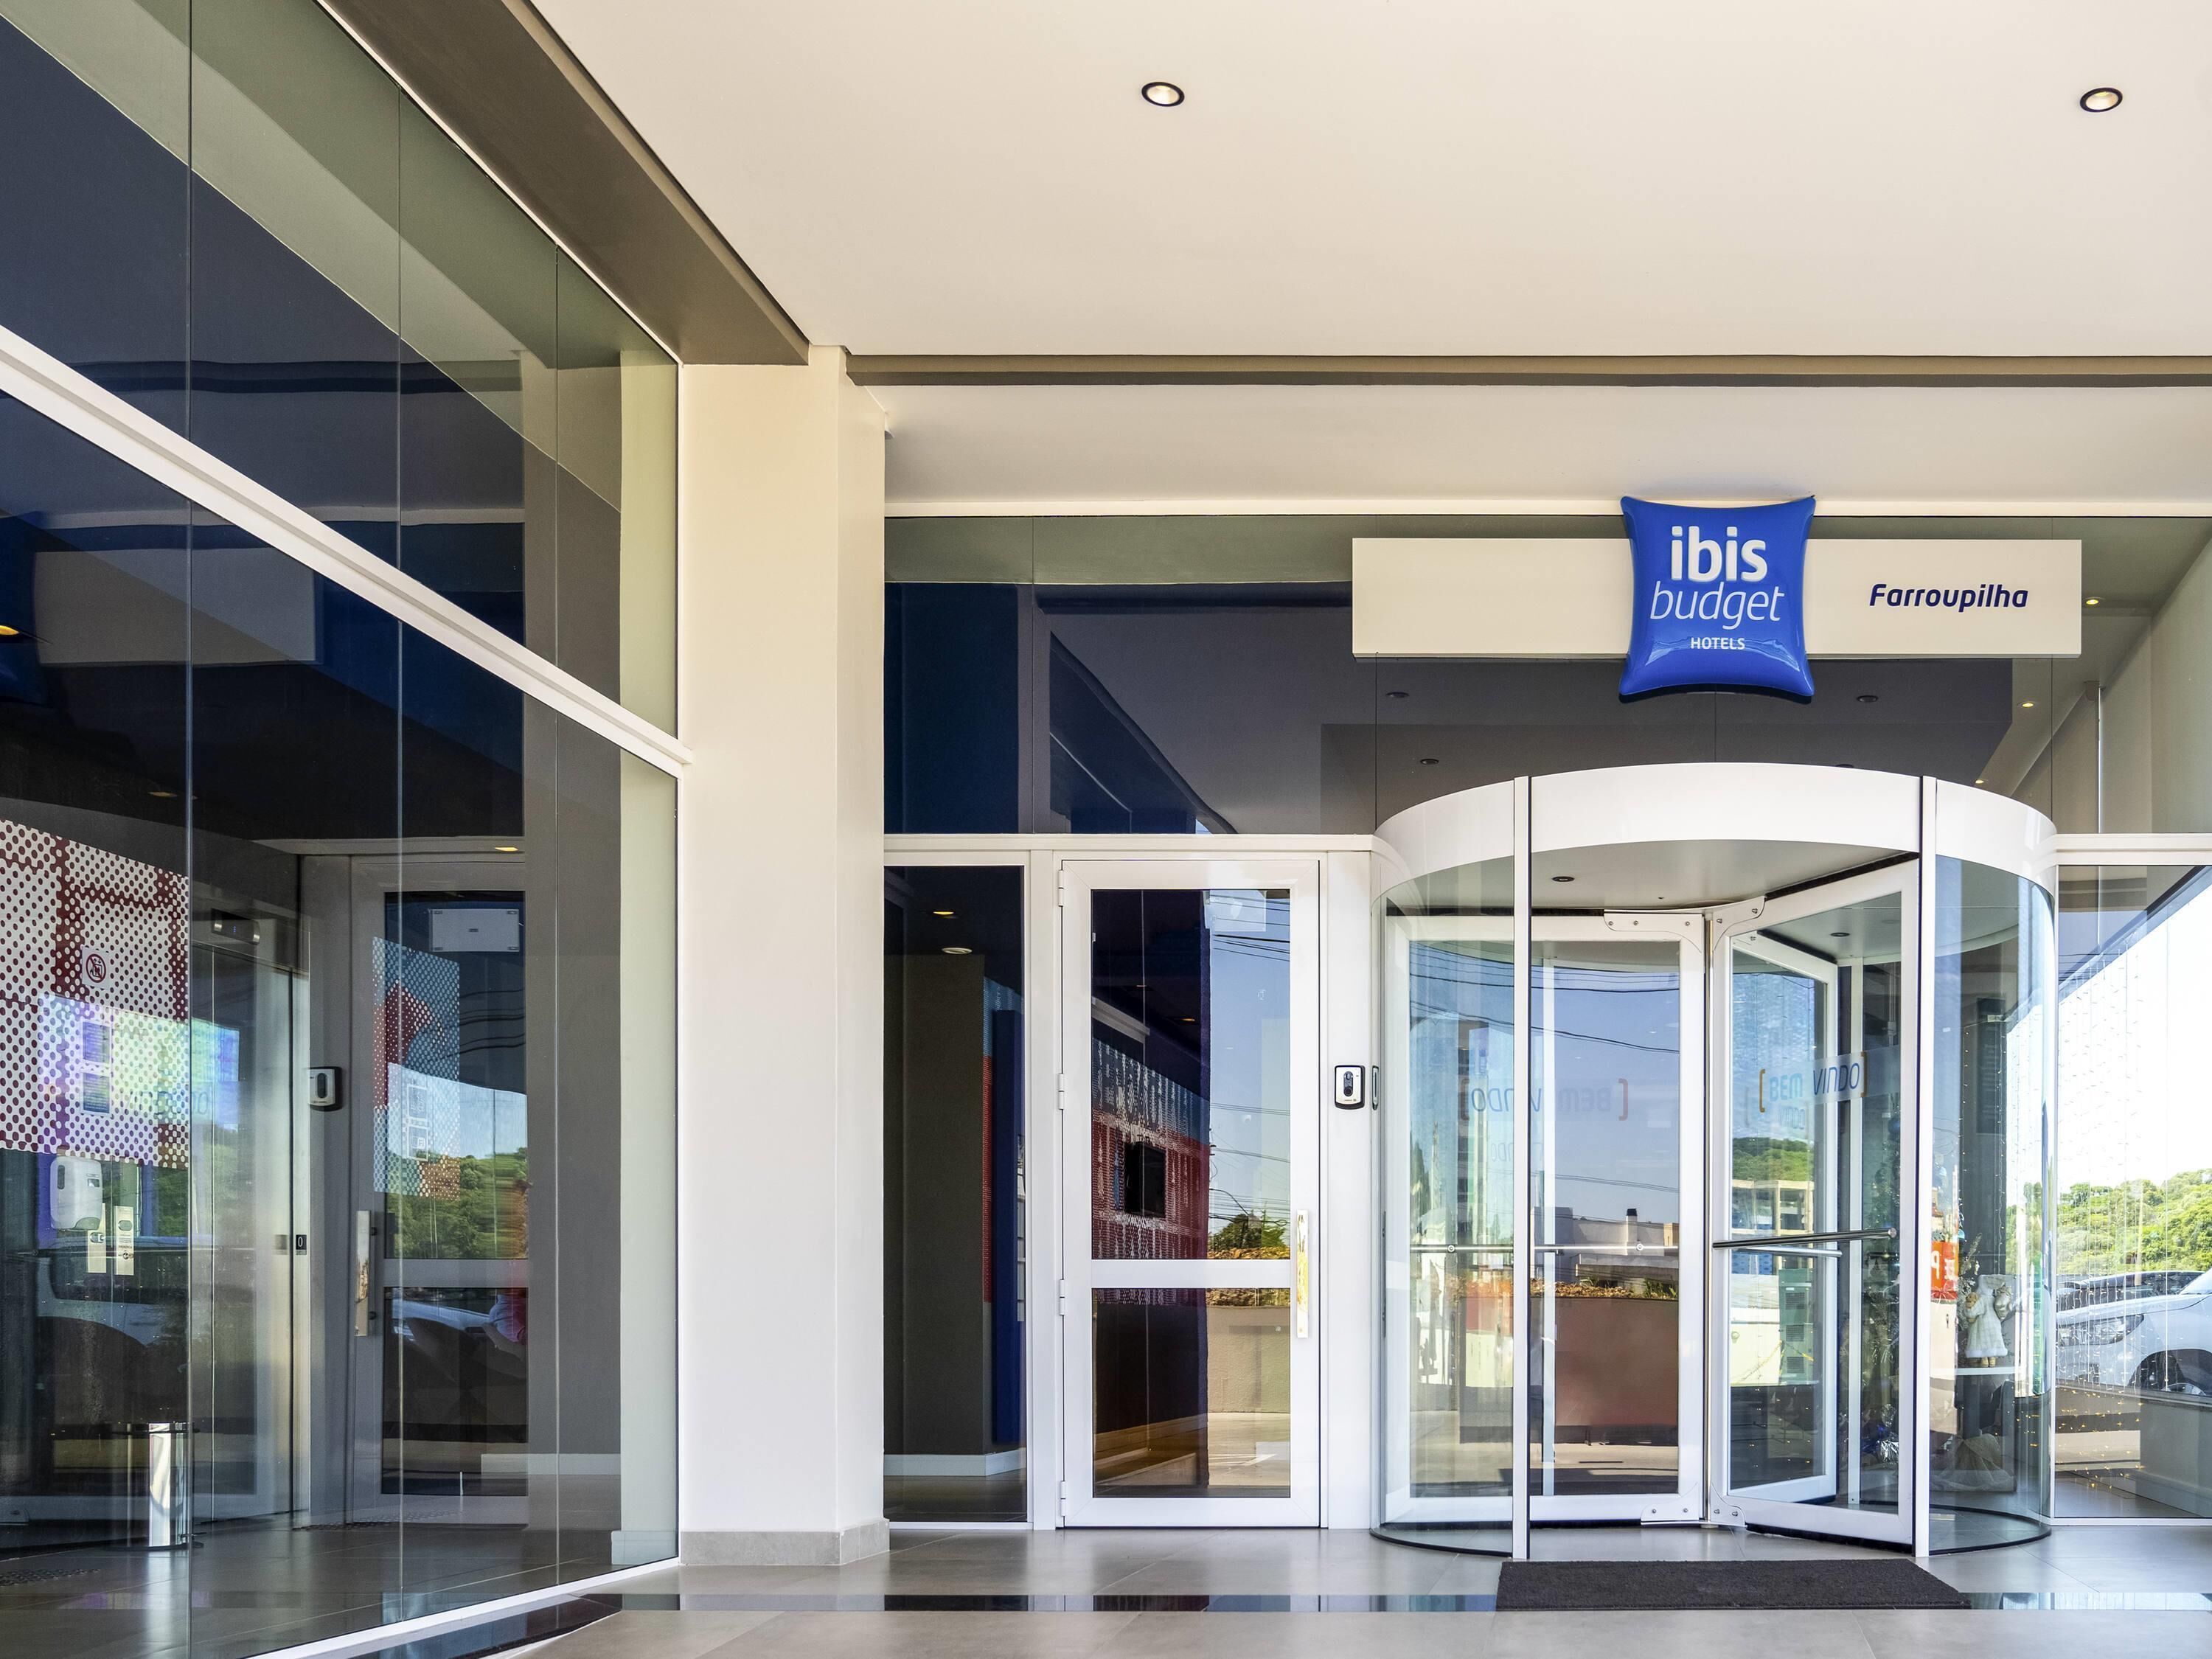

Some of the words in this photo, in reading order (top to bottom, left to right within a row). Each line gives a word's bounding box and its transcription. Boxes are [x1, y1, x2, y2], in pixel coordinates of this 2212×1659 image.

[1671, 526, 1768, 582] ibis
[1650, 580, 1785, 630] budget
[1869, 584, 2028, 613] Farroupilha
[1690, 637, 1745, 650] HOTELS
